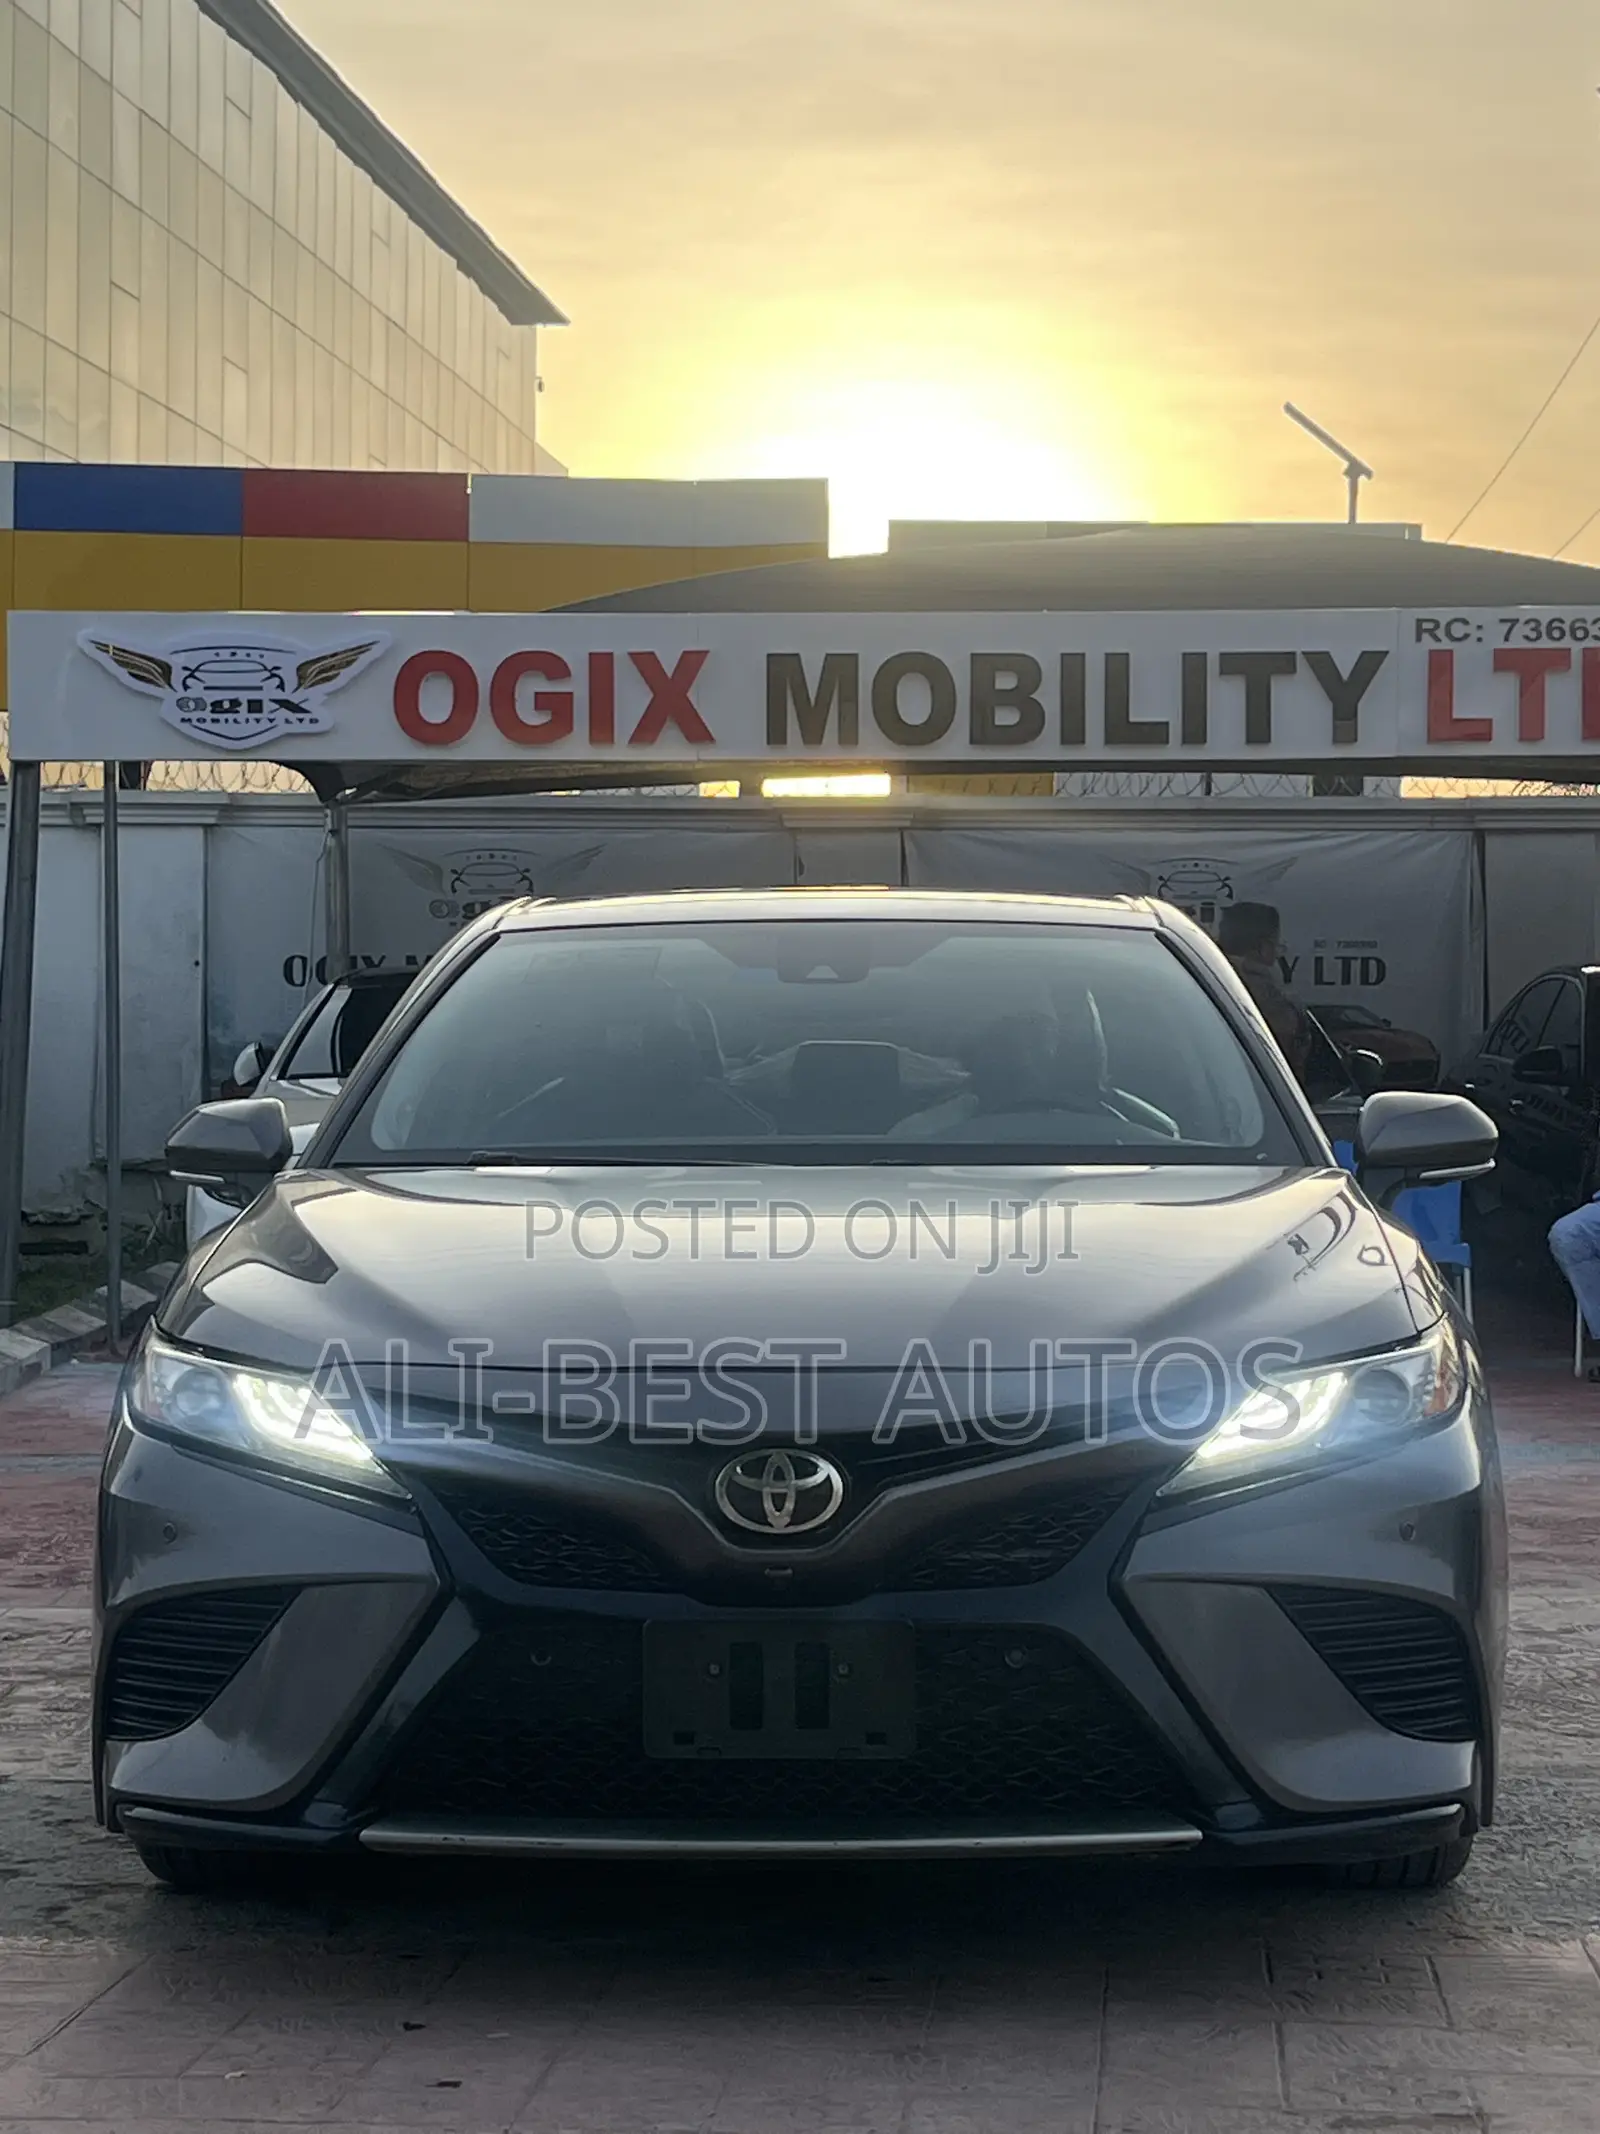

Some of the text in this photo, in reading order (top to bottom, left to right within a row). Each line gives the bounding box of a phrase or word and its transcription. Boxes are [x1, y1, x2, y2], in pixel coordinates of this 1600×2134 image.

[1414, 617, 1484, 643] RC:
[392, 646, 1600, 747] OGIX MOBILITY LT
[1313, 955, 1387, 987] LTD
